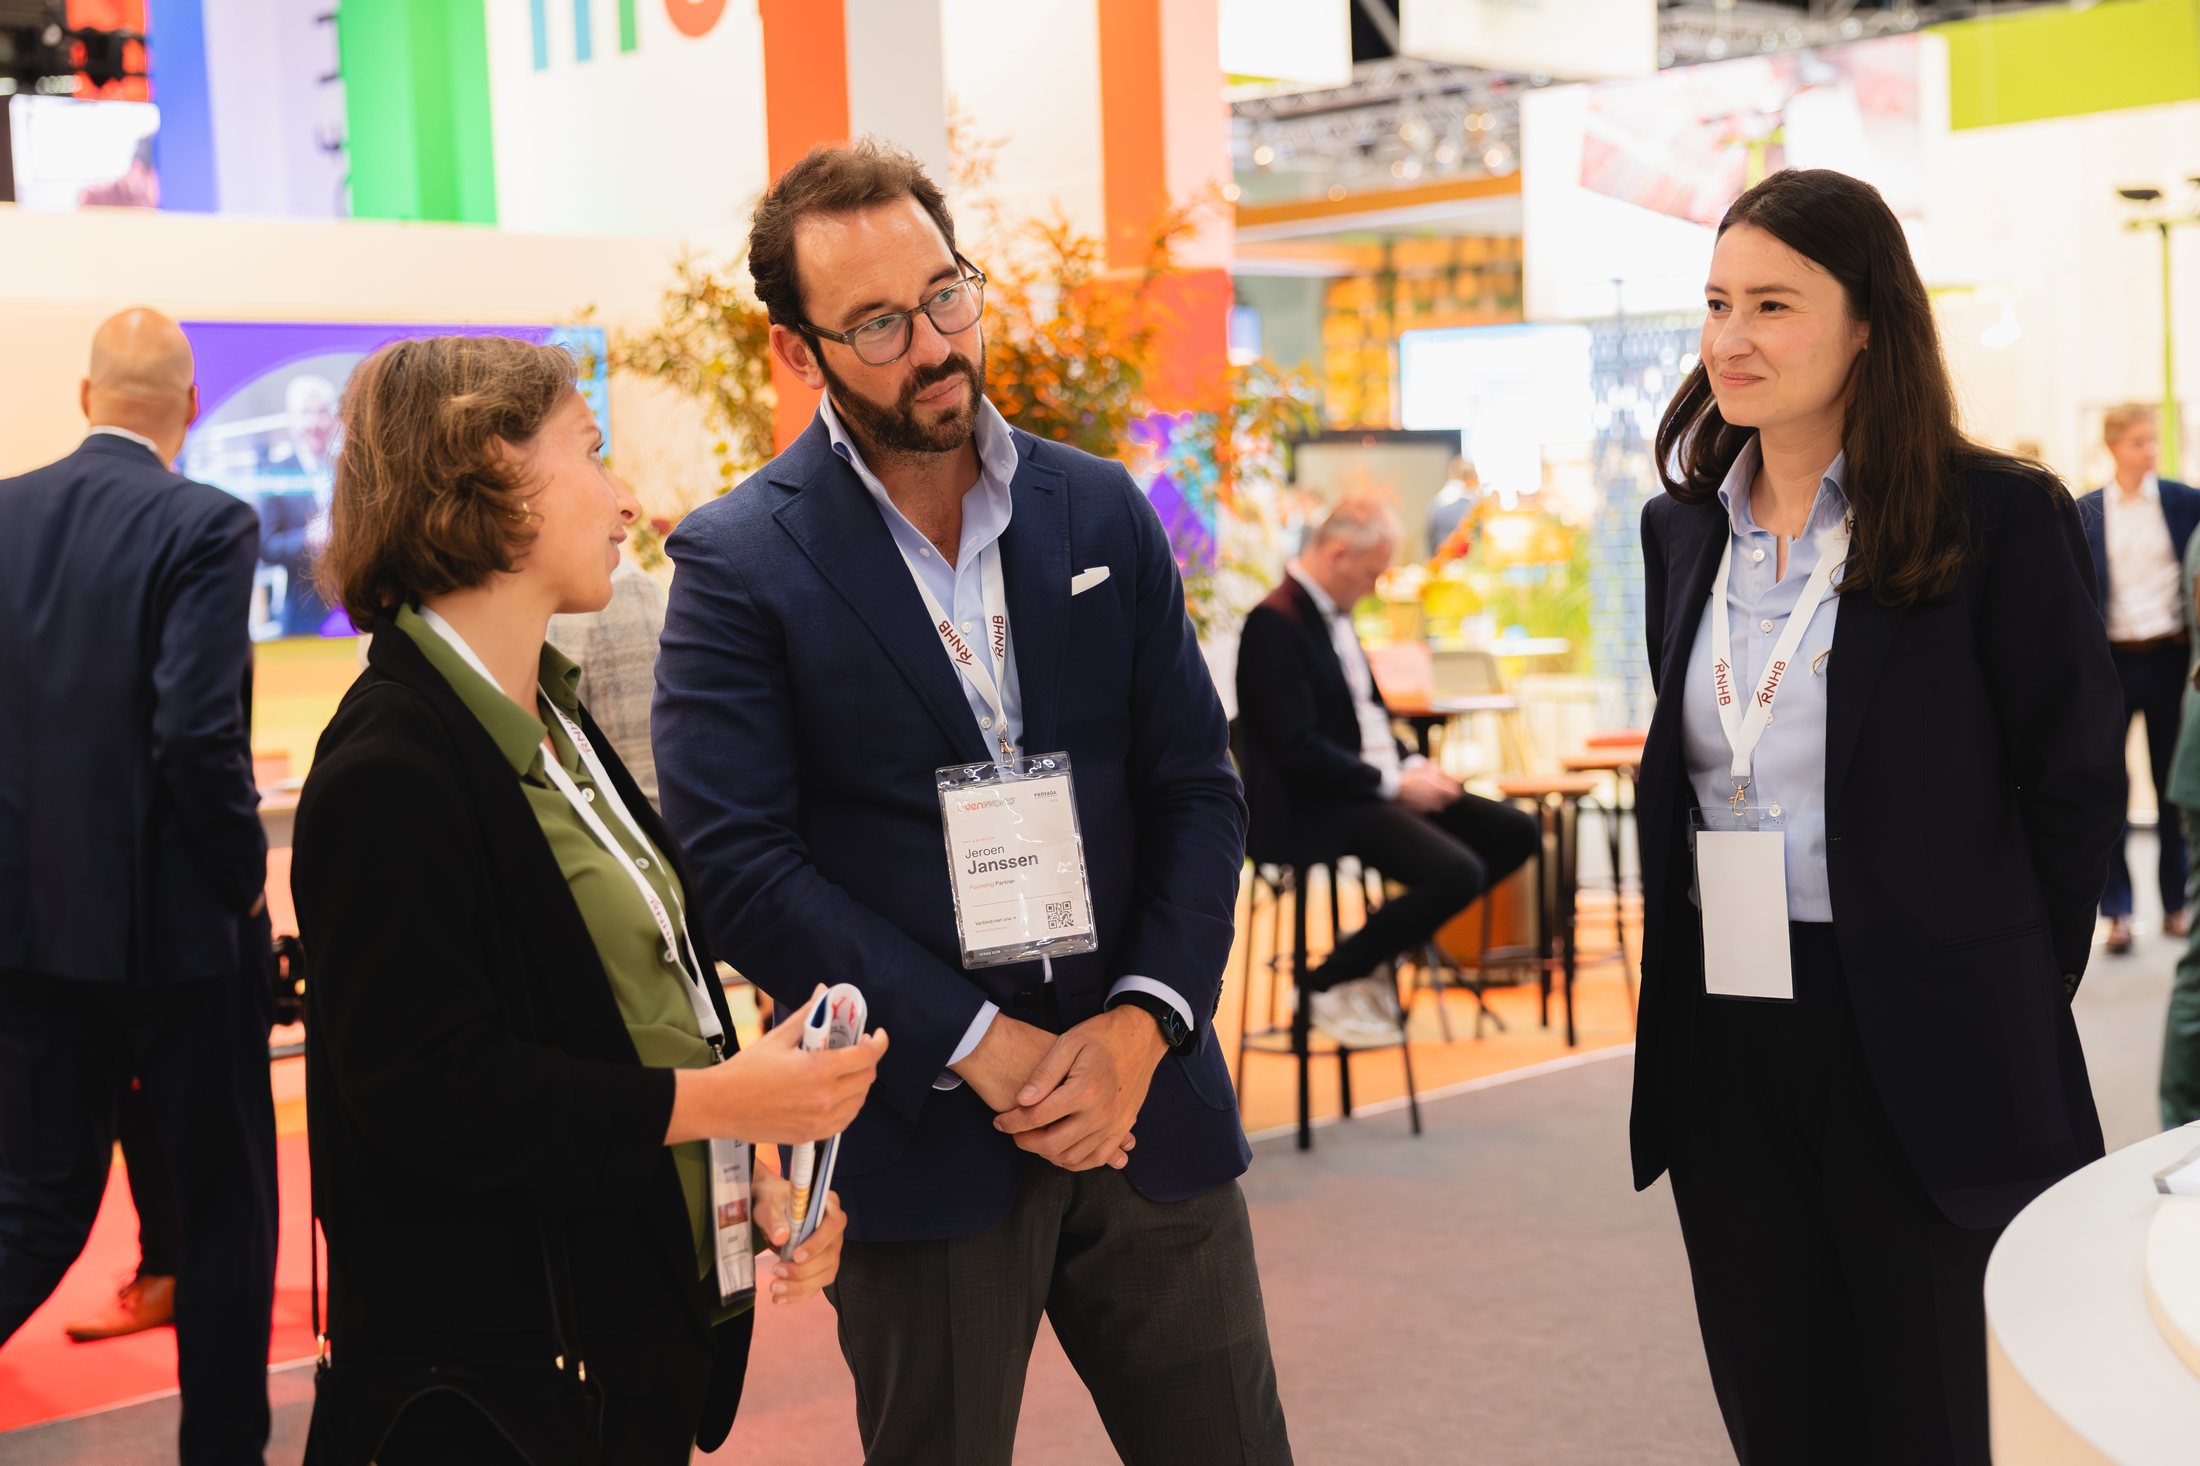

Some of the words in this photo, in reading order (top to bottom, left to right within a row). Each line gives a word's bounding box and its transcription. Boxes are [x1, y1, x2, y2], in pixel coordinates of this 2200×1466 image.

[939, 620, 972, 665] RNHB
[992, 615, 1004, 660] RNHB
[1714, 658, 1731, 706] RNHB
[1757, 660, 1786, 707] RNHB
[965, 845, 1005, 859] Jeroen
[967, 854, 1039, 875] Janssen
